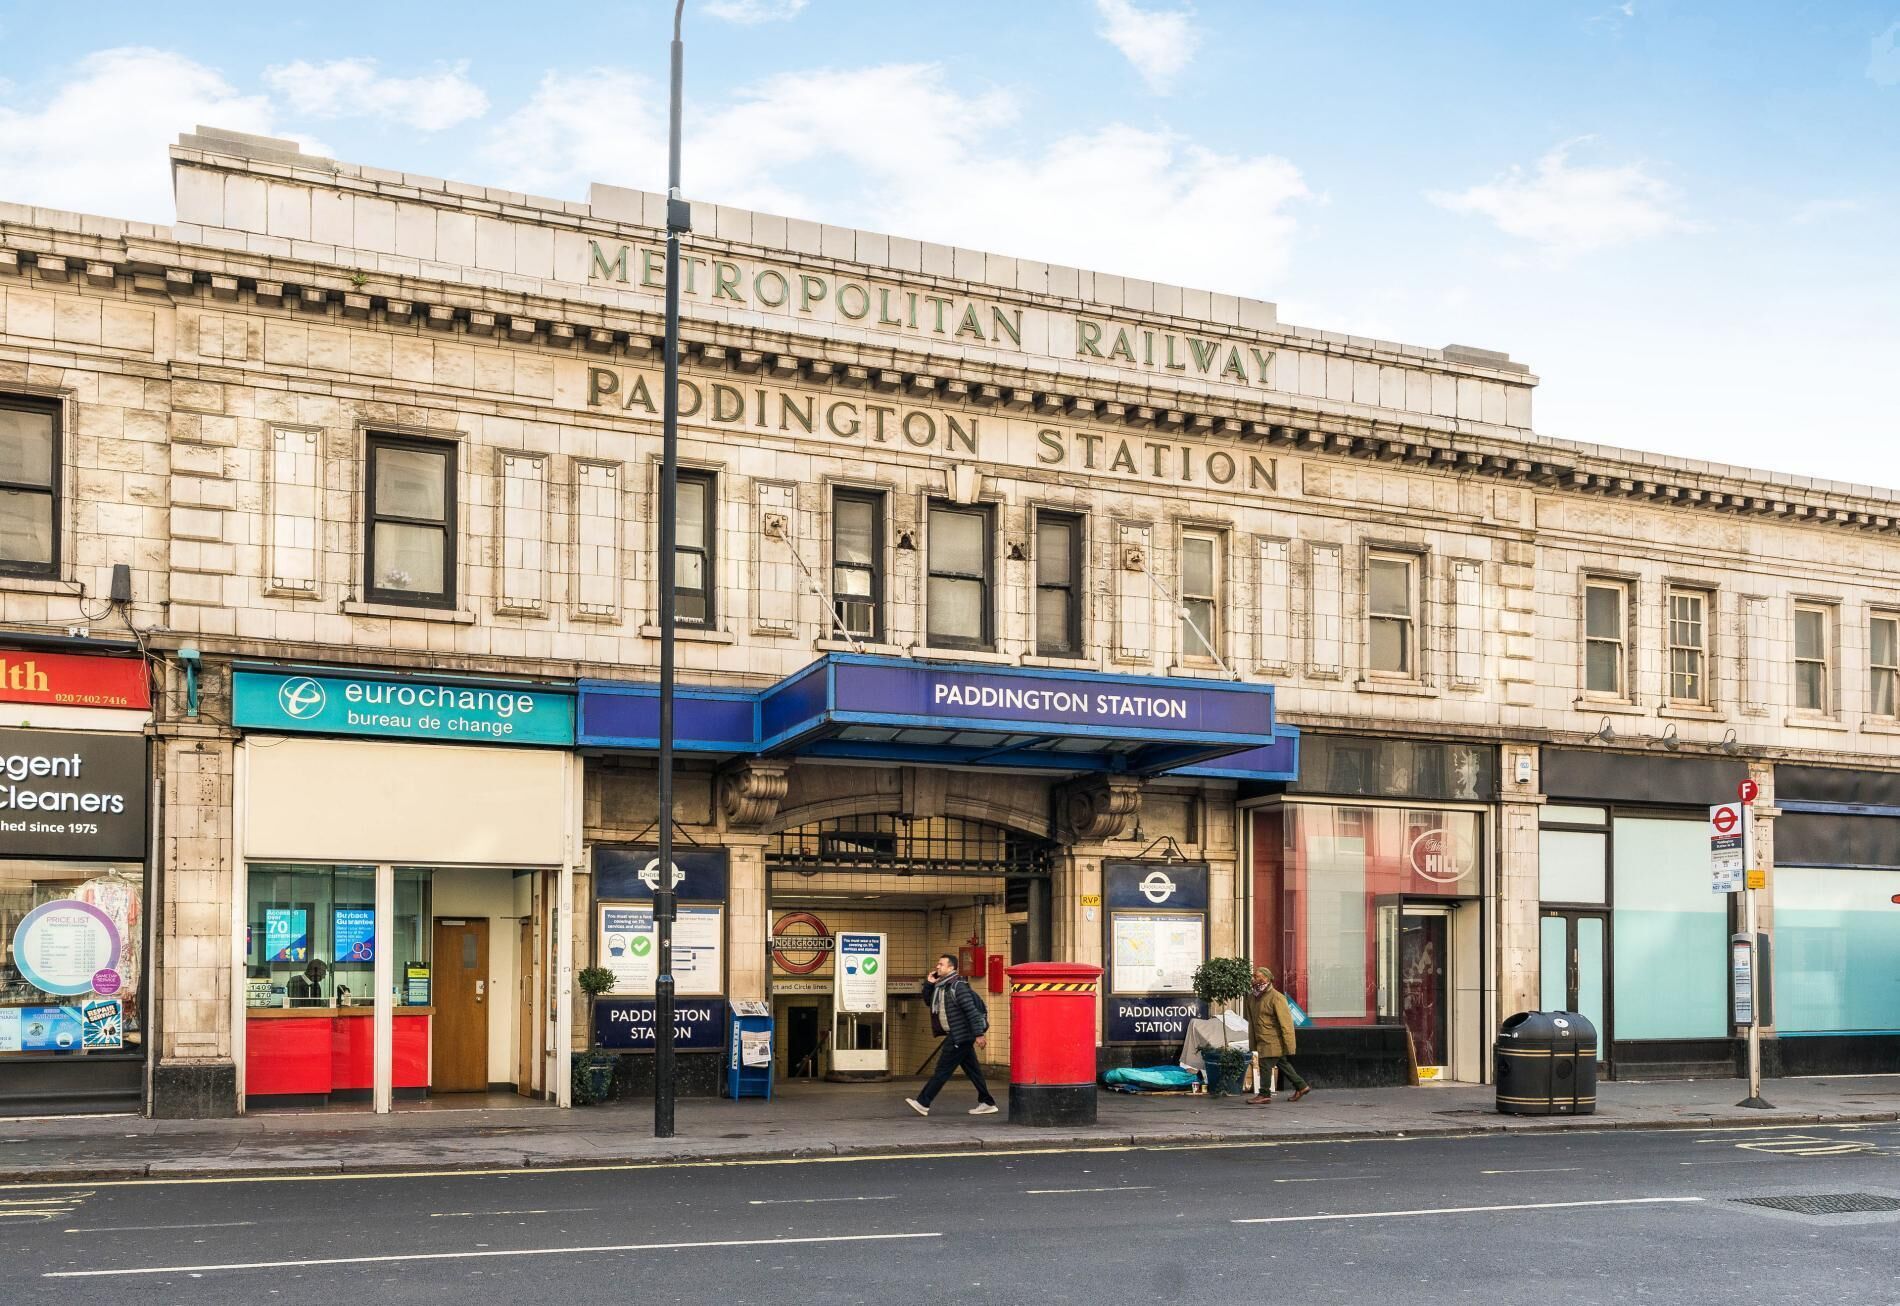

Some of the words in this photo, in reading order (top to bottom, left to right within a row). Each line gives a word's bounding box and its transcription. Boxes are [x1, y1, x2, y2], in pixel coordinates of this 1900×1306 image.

[588, 240, 1024, 347] METROPOLITAN
[1076, 318, 1277, 385] RAILWAY
[587, 366, 979, 455] PADDINGTON
[1036, 428, 1280, 491] STATION
[55, 693, 74, 703] 020
[77, 694, 101, 704] 7402
[103, 696, 128, 705] 7416
[345, 683, 534, 718] eurochange
[934, 683, 1089, 715] PADDINGTON
[1096, 693, 1188, 720] STATION
[347, 710, 411, 728] bureau
[418, 714, 441, 730] de
[448, 716, 513, 737] change
[0, 754, 81, 780] gent
[1742, 782, 1751, 800] F
[29, 822, 65, 834] since
[68, 823, 98, 835] 1975
[1425, 855, 1459, 872] HILL
[1082, 896, 1099, 904] RVP
[46, 916, 72, 924] PRICE
[73, 916, 89, 924] LIST
[268, 920, 288, 934] 70
[86, 1004, 115, 1017] REPAIR
[611, 1009, 711, 1022] PADDIGTON
[1119, 1005, 1197, 1018] PADDINGTON
[631, 1027, 691, 1039] STAON
[1134, 1021, 1182, 1033] STATION
